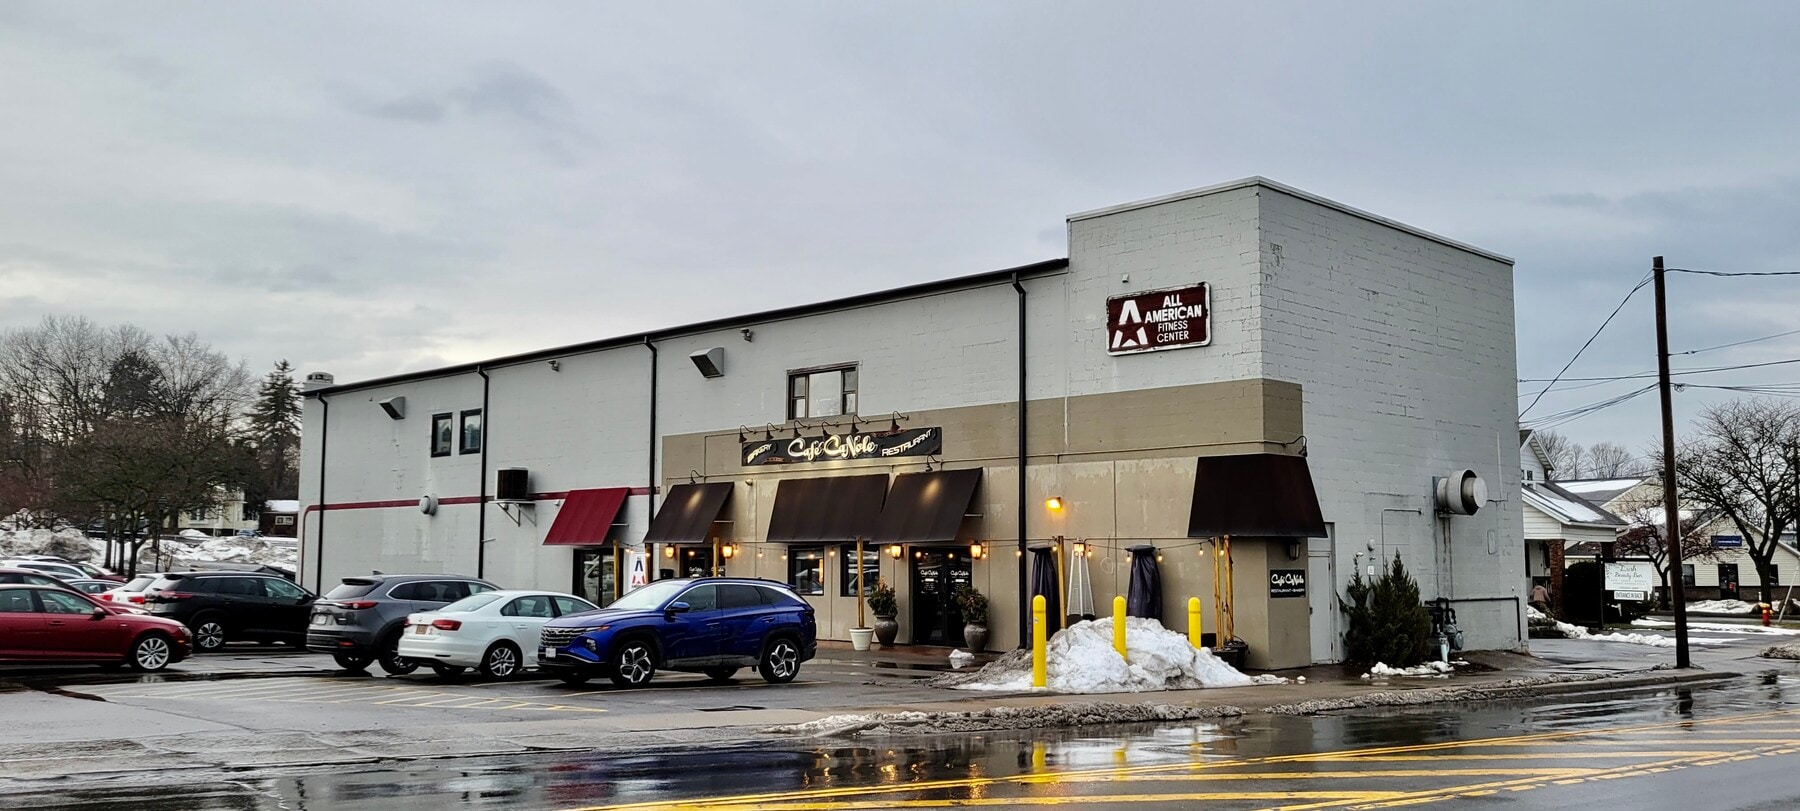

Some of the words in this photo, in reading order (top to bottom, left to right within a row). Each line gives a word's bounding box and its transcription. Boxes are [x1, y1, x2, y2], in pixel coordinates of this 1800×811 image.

[1162, 294, 1183, 308] ALL
[1144, 304, 1202, 324] AMERICAN
[1156, 330, 1189, 343] CENTER
[1157, 320, 1188, 333] FITNESS
[787, 437, 825, 461] Café
[881, 428, 932, 457] RESTAURANT
[747, 443, 773, 464] BAKERY
